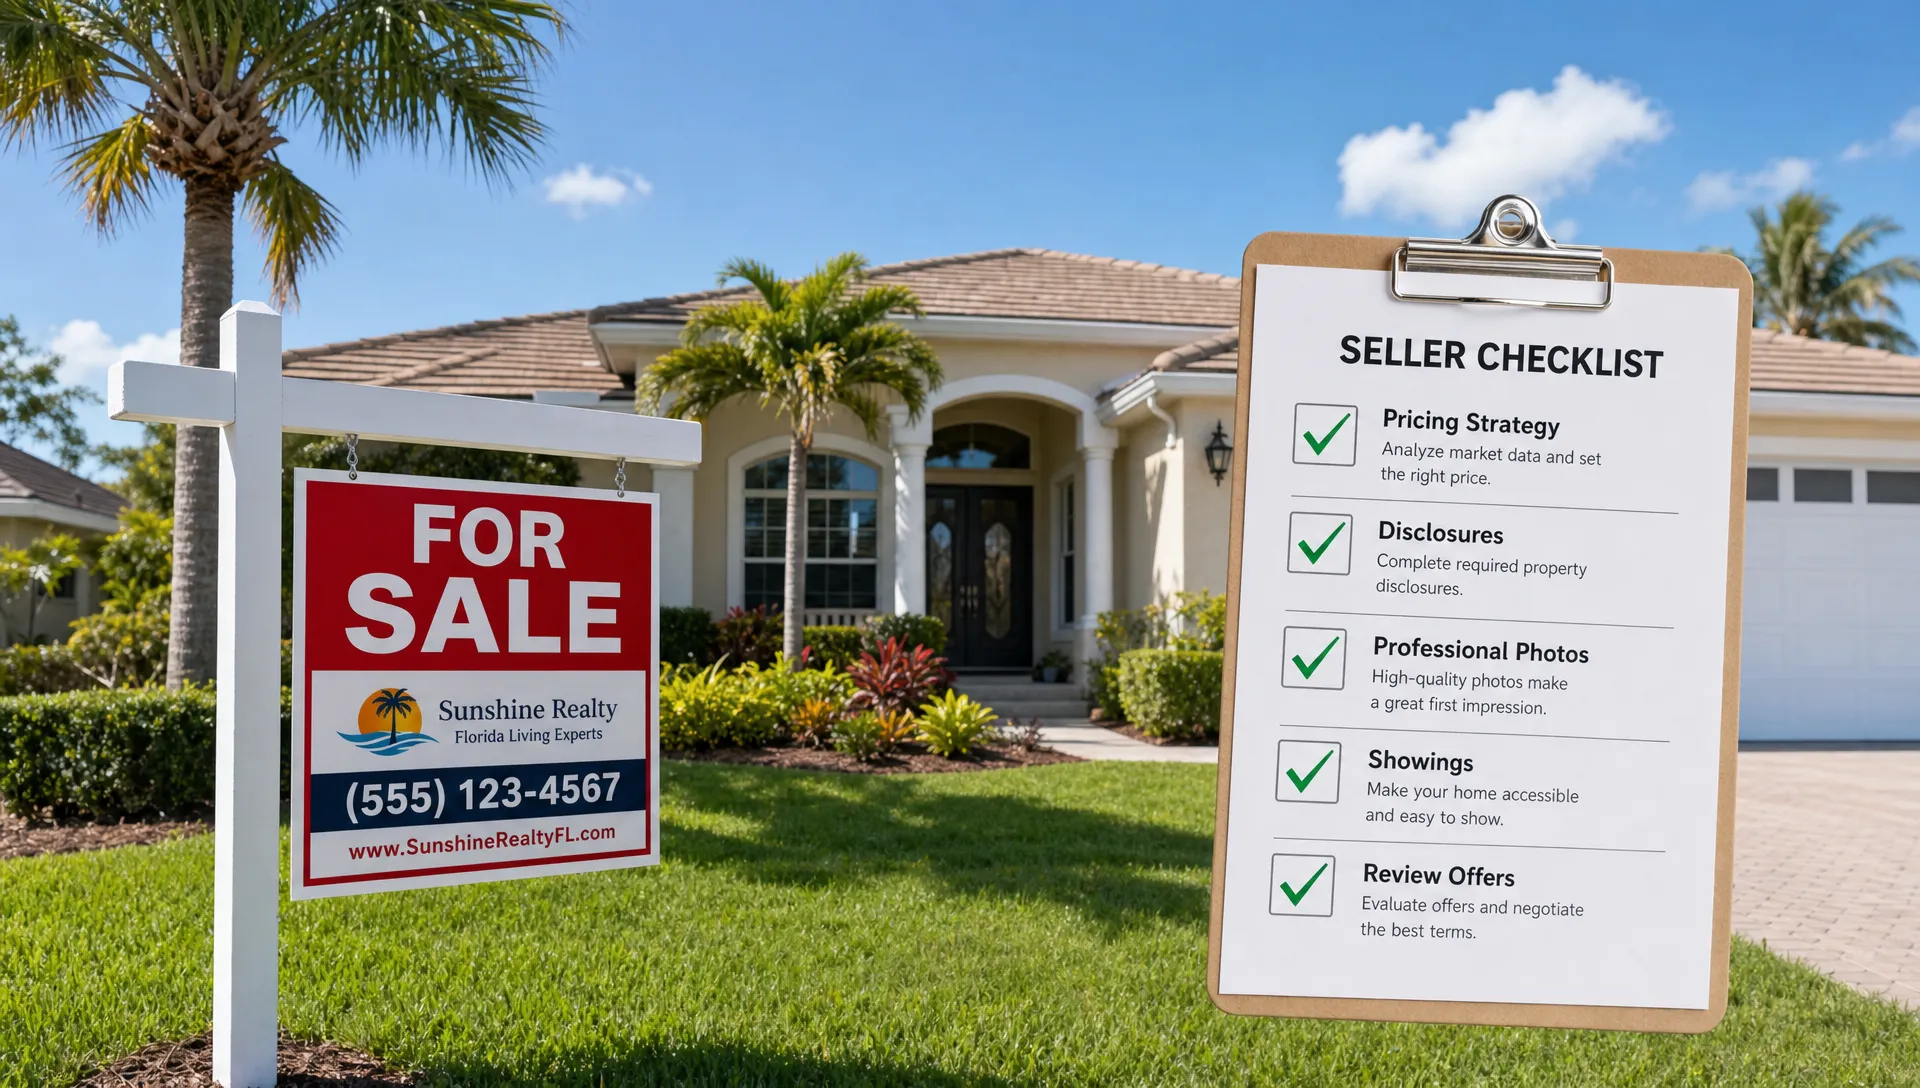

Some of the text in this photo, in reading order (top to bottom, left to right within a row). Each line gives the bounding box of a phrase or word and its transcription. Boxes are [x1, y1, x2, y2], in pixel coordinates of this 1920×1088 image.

[1339, 334, 1665, 379] SELLER CHECKLIST
[1383, 407, 1561, 441] Pricing Strategy
[1381, 441, 1602, 466] Analyze market data and set
[1380, 465, 1491, 488] the right price.
[413, 503, 566, 569] FOR
[1378, 520, 1504, 545] Disclosures
[1376, 552, 1588, 580] Complete required property
[1375, 578, 1463, 596] disclosures.
[345, 572, 622, 655] SALE
[1373, 635, 1589, 664] Professional Photos
[1372, 668, 1569, 691] High-quality photos make
[438, 697, 619, 724] Sunshine Realty
[1370, 696, 1547, 717] a great first impression.
[454, 727, 603, 745] Florida Living Experts
[1368, 749, 1474, 777] Showings
[346, 771, 621, 824] (555) 123-4567
[1367, 781, 1580, 804] Make your home accessible
[1365, 807, 1504, 828] and easy to show.
[348, 826, 616, 860] www.SunshineRealtyFL.com
[1363, 862, 1515, 888] Review Offers
[1362, 895, 1584, 920] Evaluate offers and negotiate
[1360, 921, 1477, 940] the best terms.
